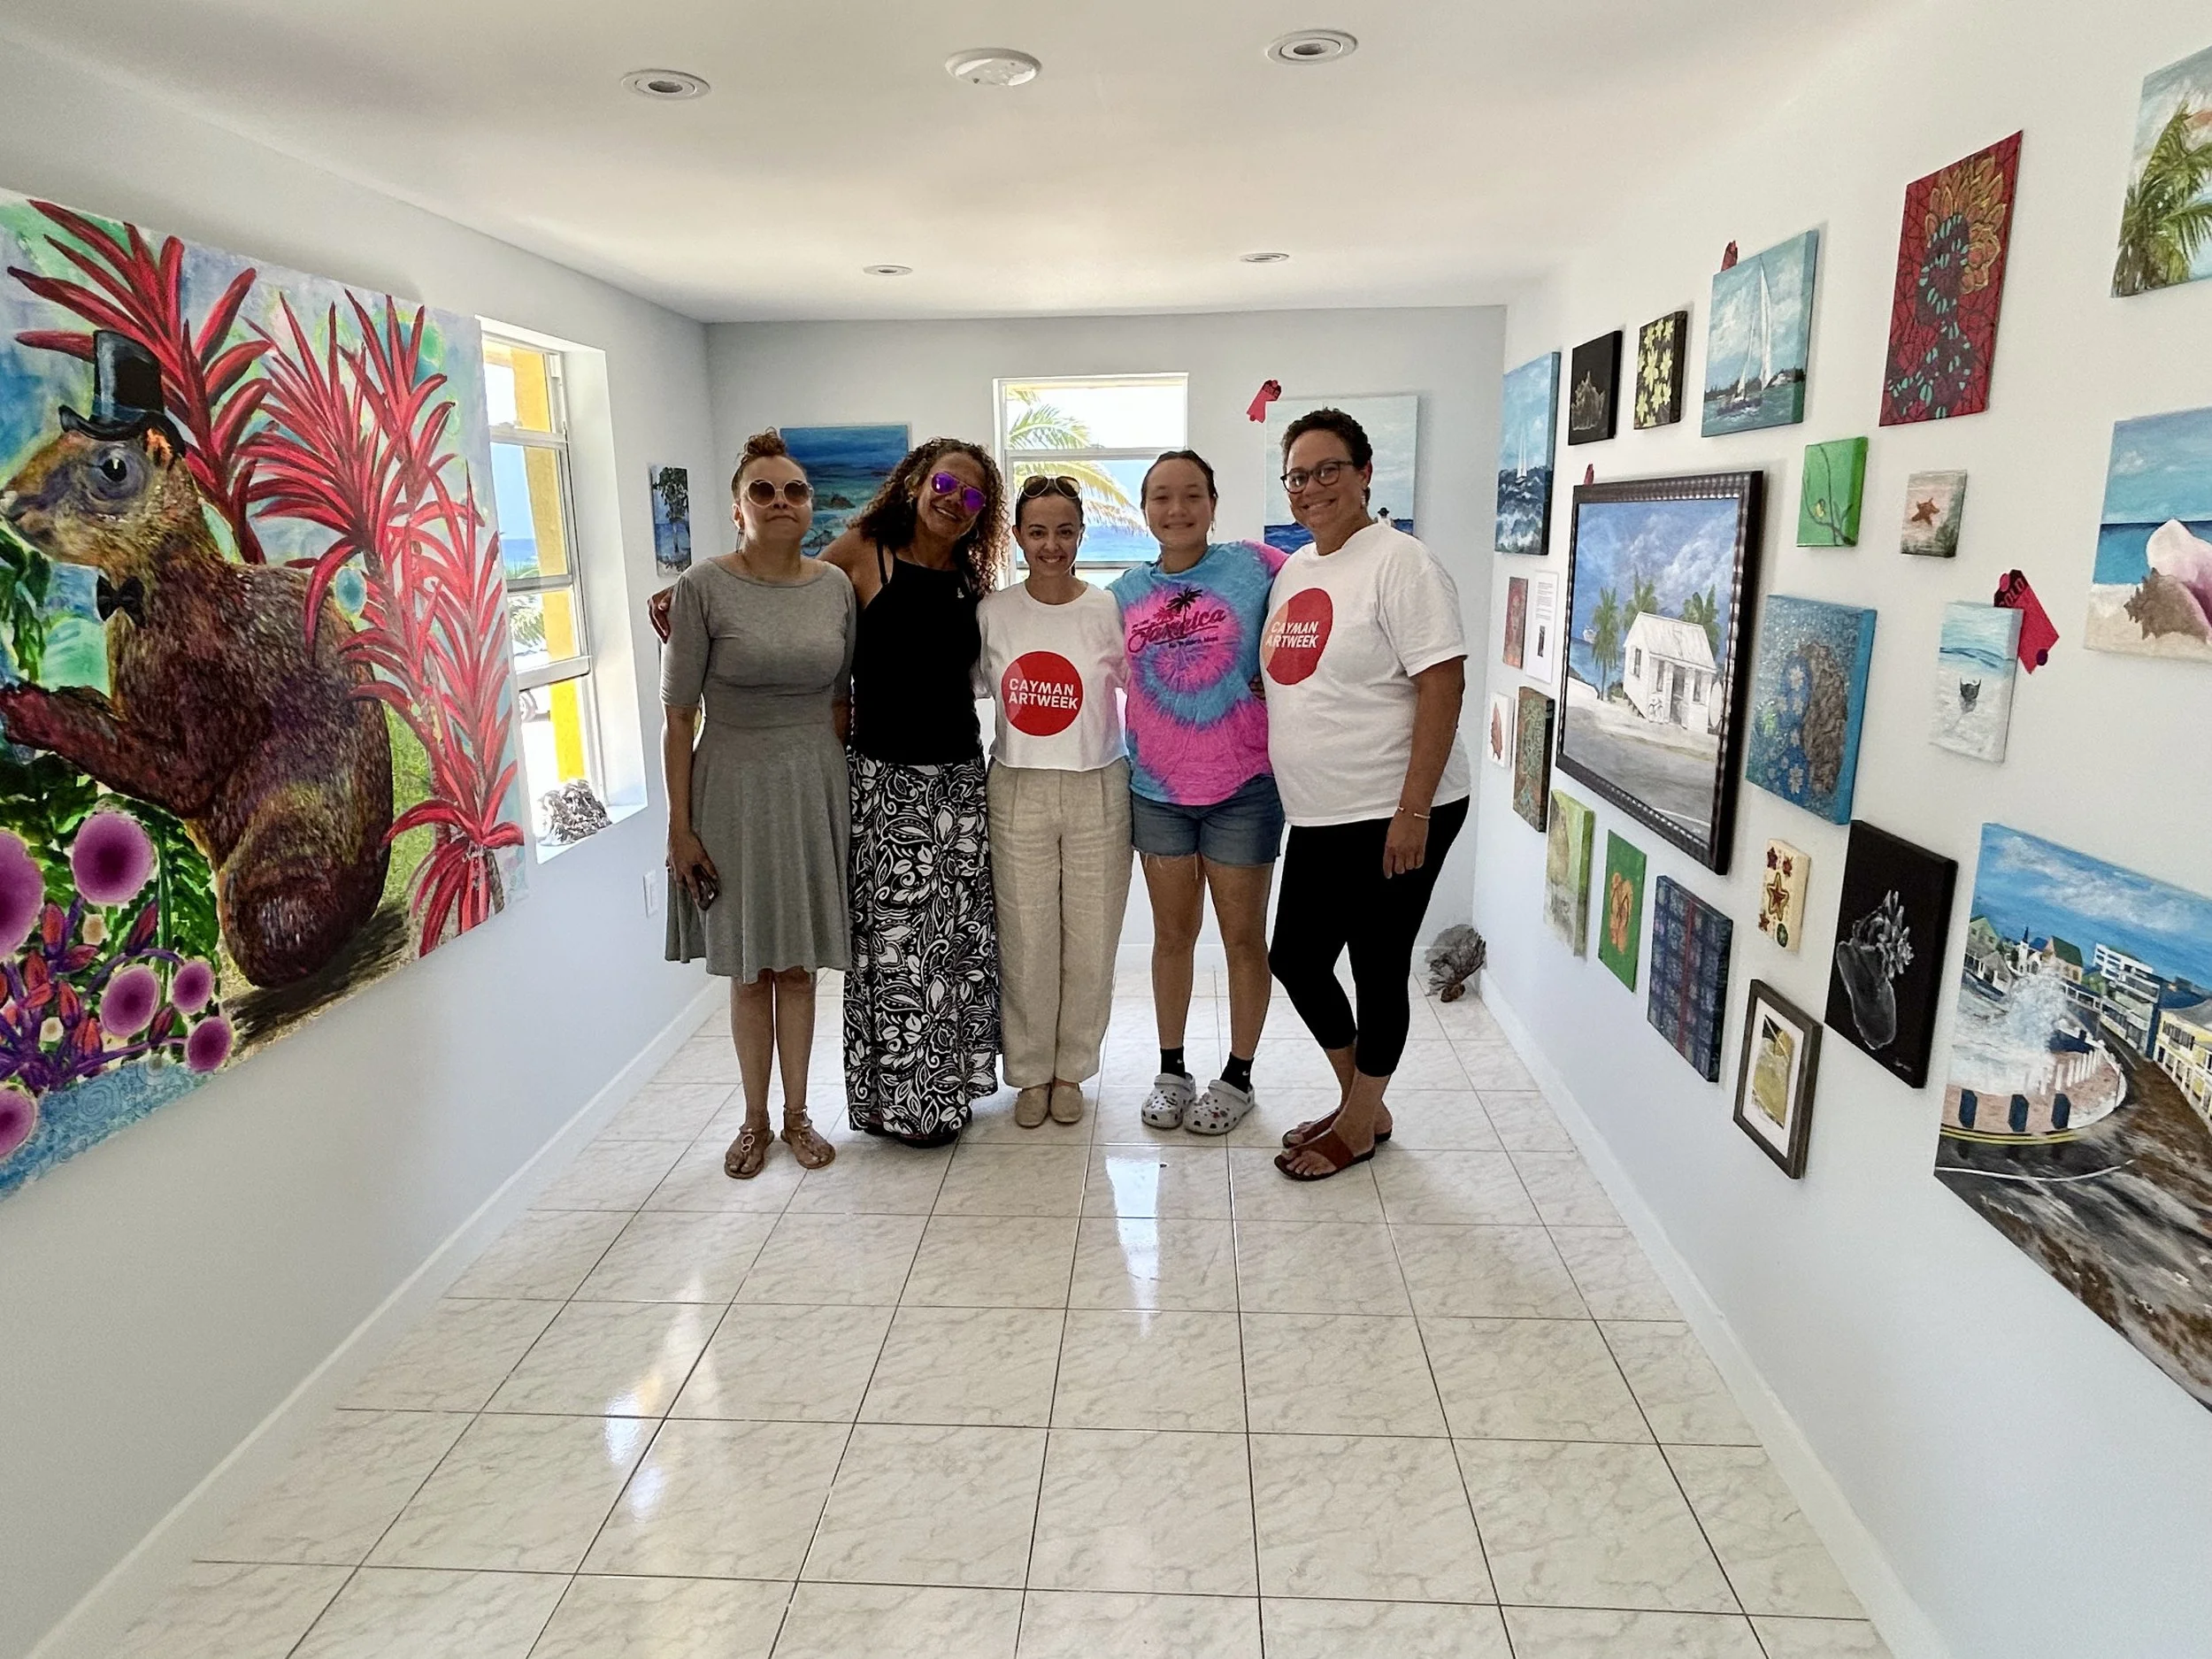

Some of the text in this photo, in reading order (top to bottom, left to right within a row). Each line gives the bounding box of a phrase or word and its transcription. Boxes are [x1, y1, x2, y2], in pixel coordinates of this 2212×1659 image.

[1271, 621, 1319, 634] CAYMAN
[1265, 634, 1319, 649] ARTWEEK
[1009, 678, 1074, 697] CAYMAN
[1008, 691, 1079, 710] ARTWEEK
